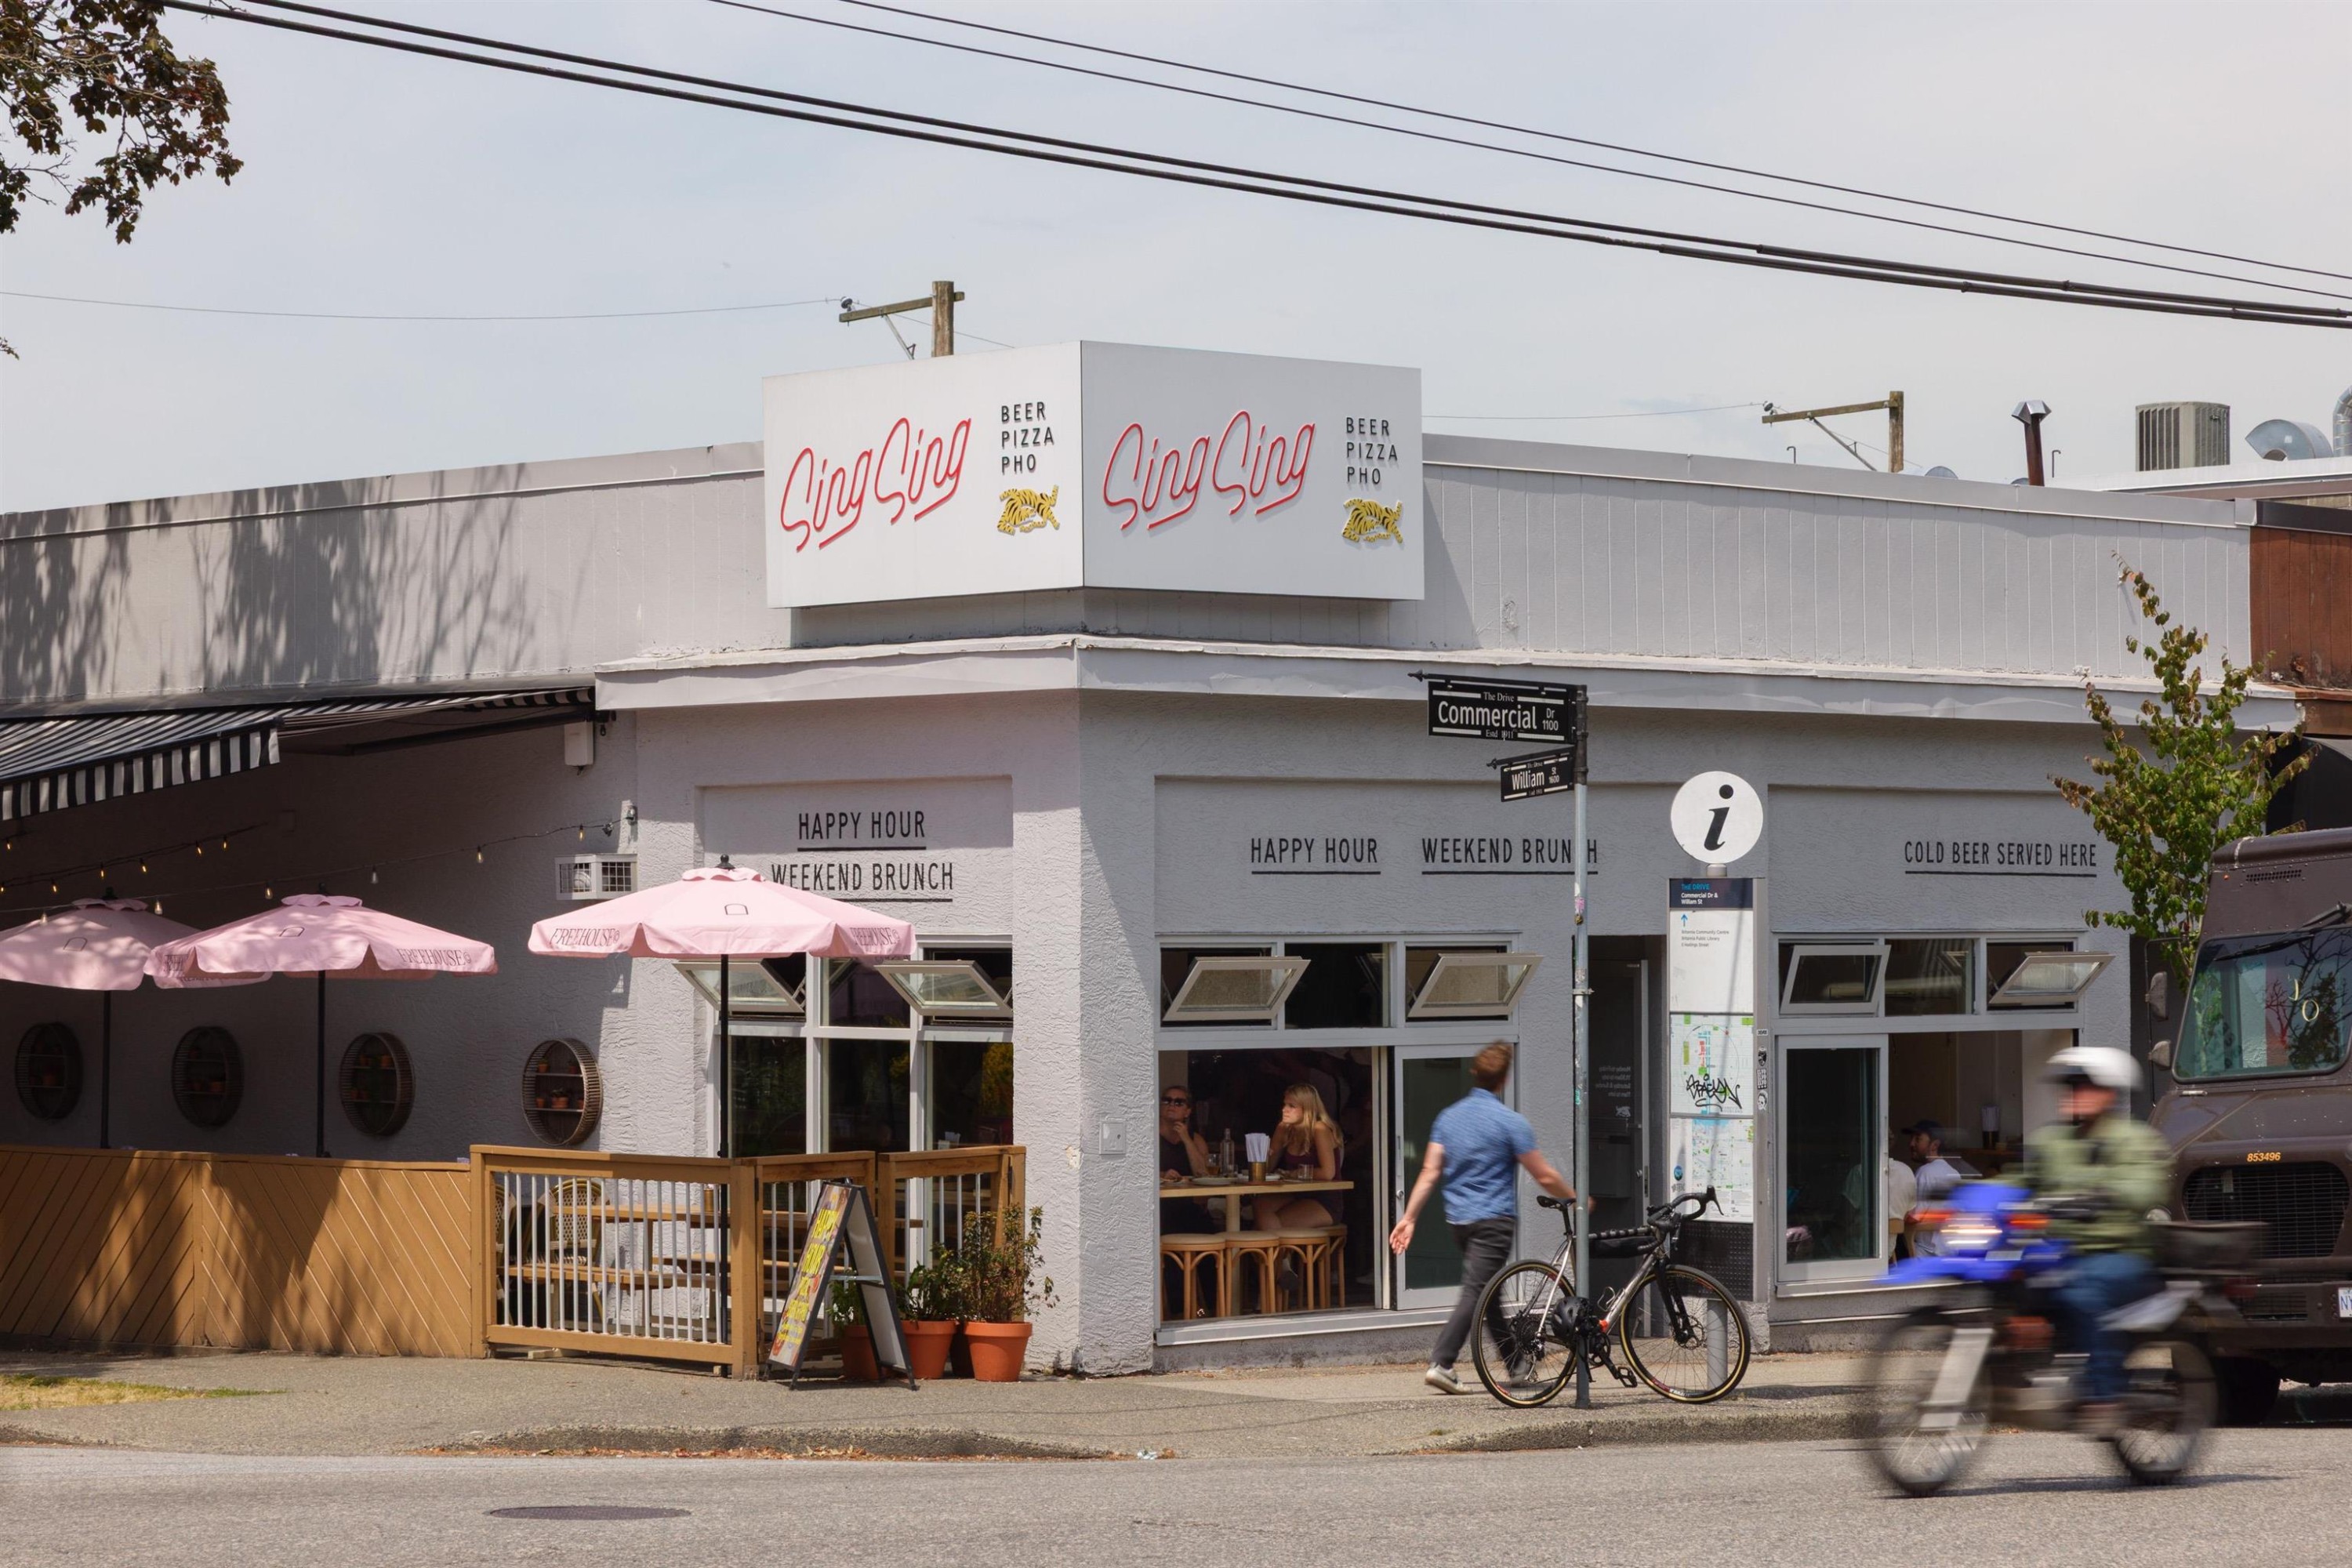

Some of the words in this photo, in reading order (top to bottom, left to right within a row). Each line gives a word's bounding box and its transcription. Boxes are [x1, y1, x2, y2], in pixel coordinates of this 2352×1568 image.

[1000, 401, 1047, 423] BEER
[1001, 426, 1054, 448] PIZZA
[1345, 416, 1391, 437] BEER
[1346, 441, 1399, 462] PIZZA
[1001, 454, 1037, 475] PHO
[1102, 422, 1211, 531] Sing
[1212, 409, 1316, 515] Sing
[1347, 466, 1381, 485] PHO
[780, 447, 873, 553] Sing
[874, 416, 971, 524] Sing
[1483, 691, 1496, 701] The
[1497, 692, 1515, 702] Drive
[1438, 701, 1537, 730] Commercial
[1546, 708, 1555, 719] Dr
[1542, 720, 1559, 731] 1100
[1501, 730, 1514, 739] 1911
[1512, 770, 1544, 790] William
[1552, 767, 1556, 775] St
[798, 812, 862, 840] HAPPY
[871, 811, 925, 838] HOUR
[1251, 837, 1315, 863] HAPPY
[1325, 838, 1377, 863] HOUR
[1421, 837, 1512, 863] WEEKEND
[1522, 838, 1598, 863] BRUNH
[1904, 841, 1944, 863] COLD
[1952, 842, 1990, 864] BEER
[1997, 843, 2053, 866] SERVED
[2060, 844, 2096, 867] HERE
[771, 863, 862, 891] WEEKEND
[872, 862, 953, 891] BRUNCH
[2247, 1152, 2281, 1162] 853496
[802, 1243, 826, 1275] HOUR
